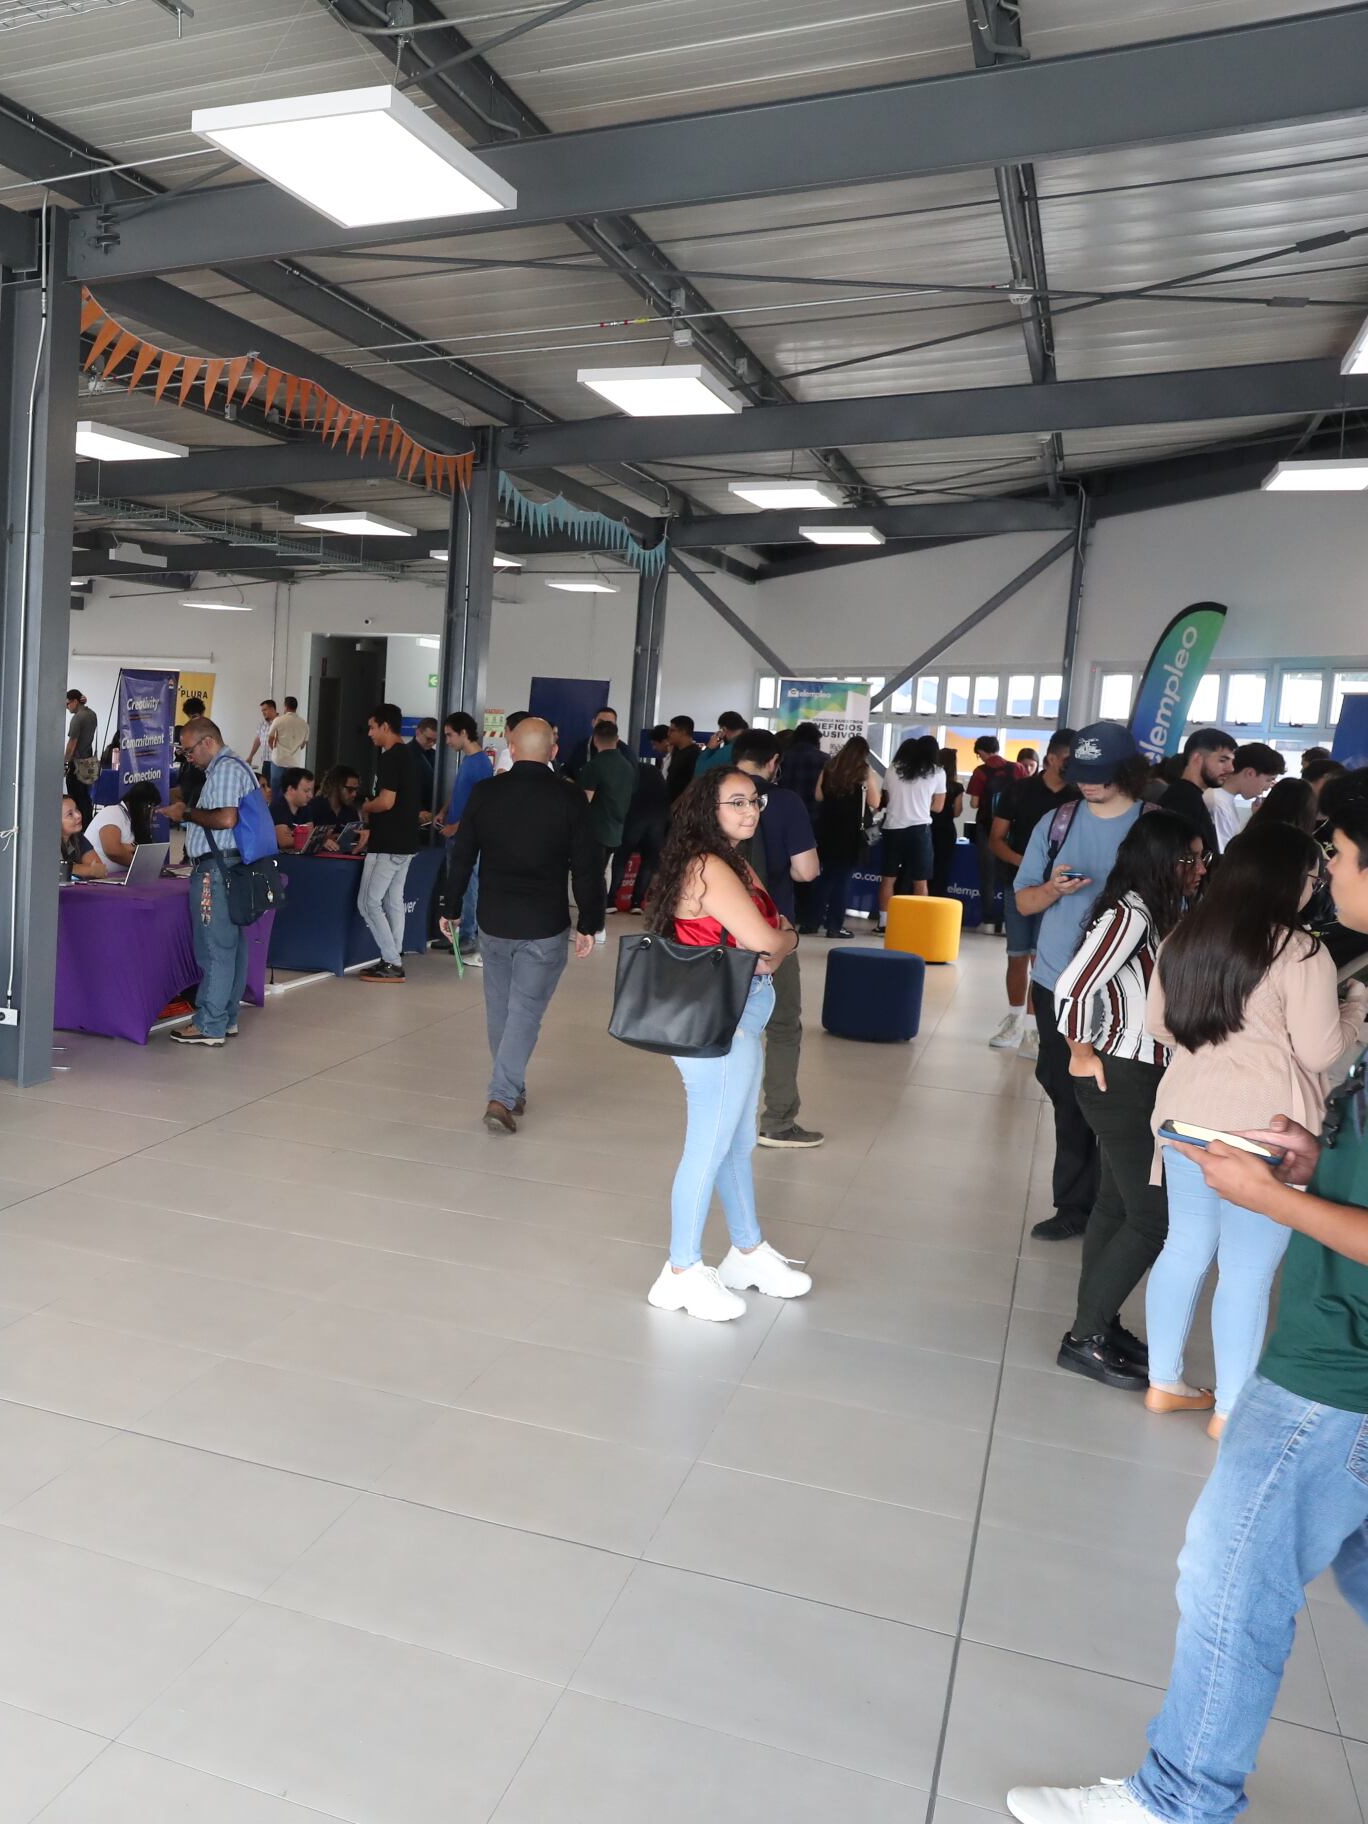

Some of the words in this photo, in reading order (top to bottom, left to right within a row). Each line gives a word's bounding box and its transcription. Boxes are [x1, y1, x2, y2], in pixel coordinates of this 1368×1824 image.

[180, 689, 209, 699] PLURA
[816, 722, 863, 732] NEFICIOS
[123, 769, 161, 785] Connection
